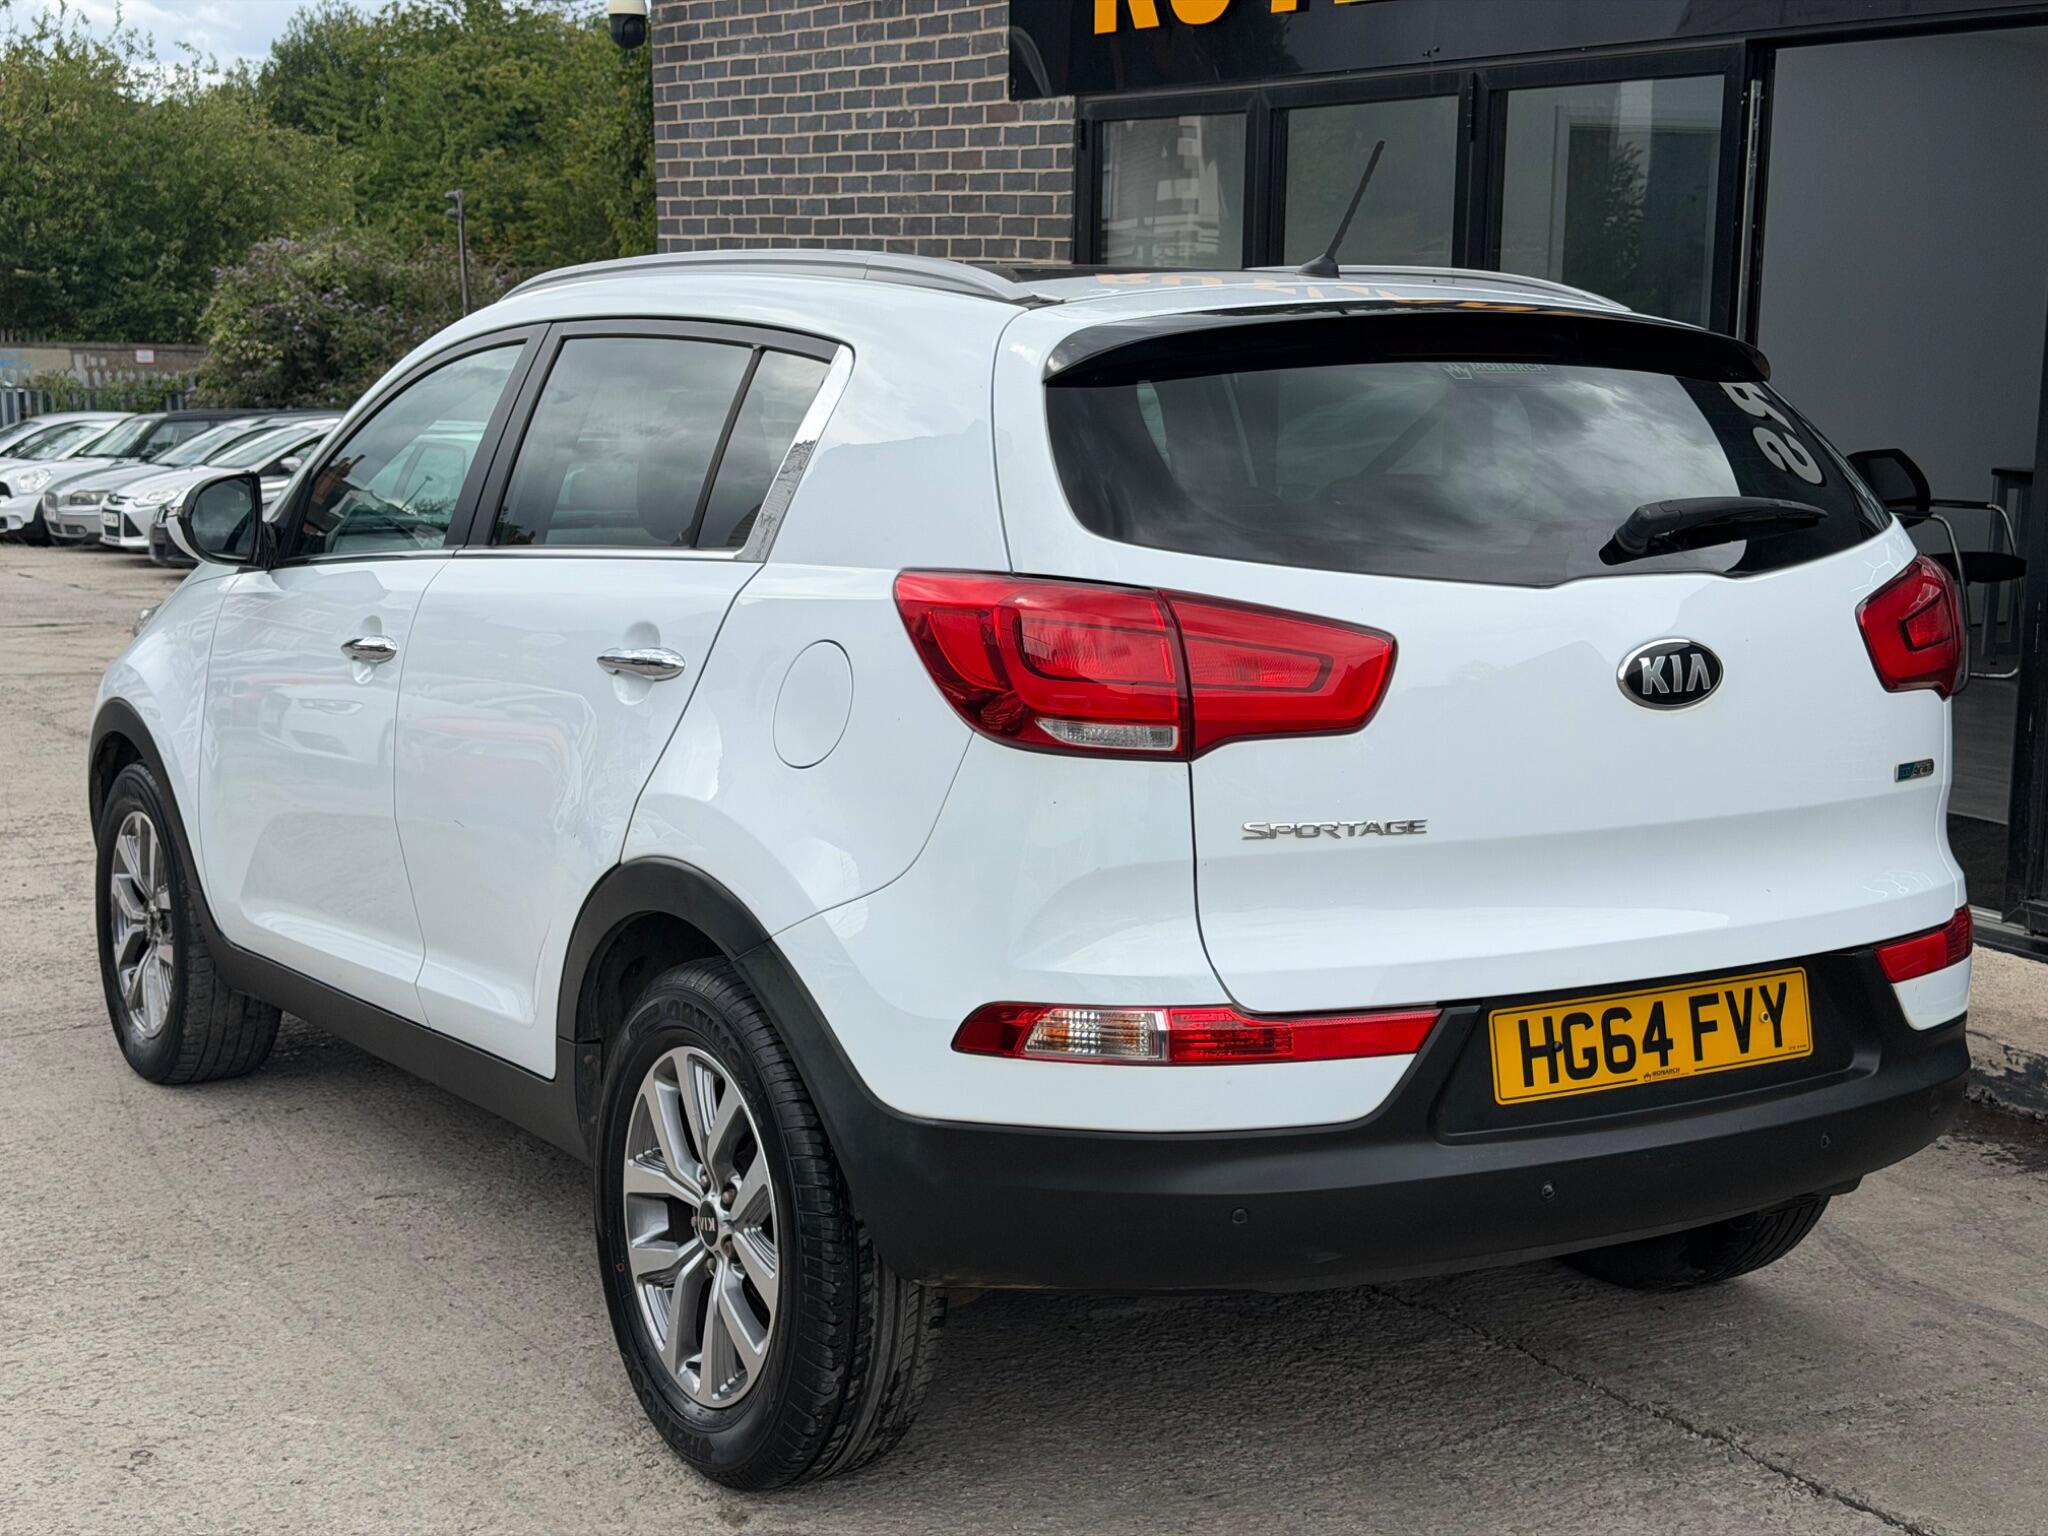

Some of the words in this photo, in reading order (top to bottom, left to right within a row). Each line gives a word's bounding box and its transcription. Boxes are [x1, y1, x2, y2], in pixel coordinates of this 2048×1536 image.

[1639, 653, 1711, 695] KIA
[1242, 819, 1428, 840] SPORTAGE
[1518, 1000, 1674, 1088] HG64
[1688, 981, 1787, 1063] FVY
[1652, 1067, 1681, 1076] MONARCH
